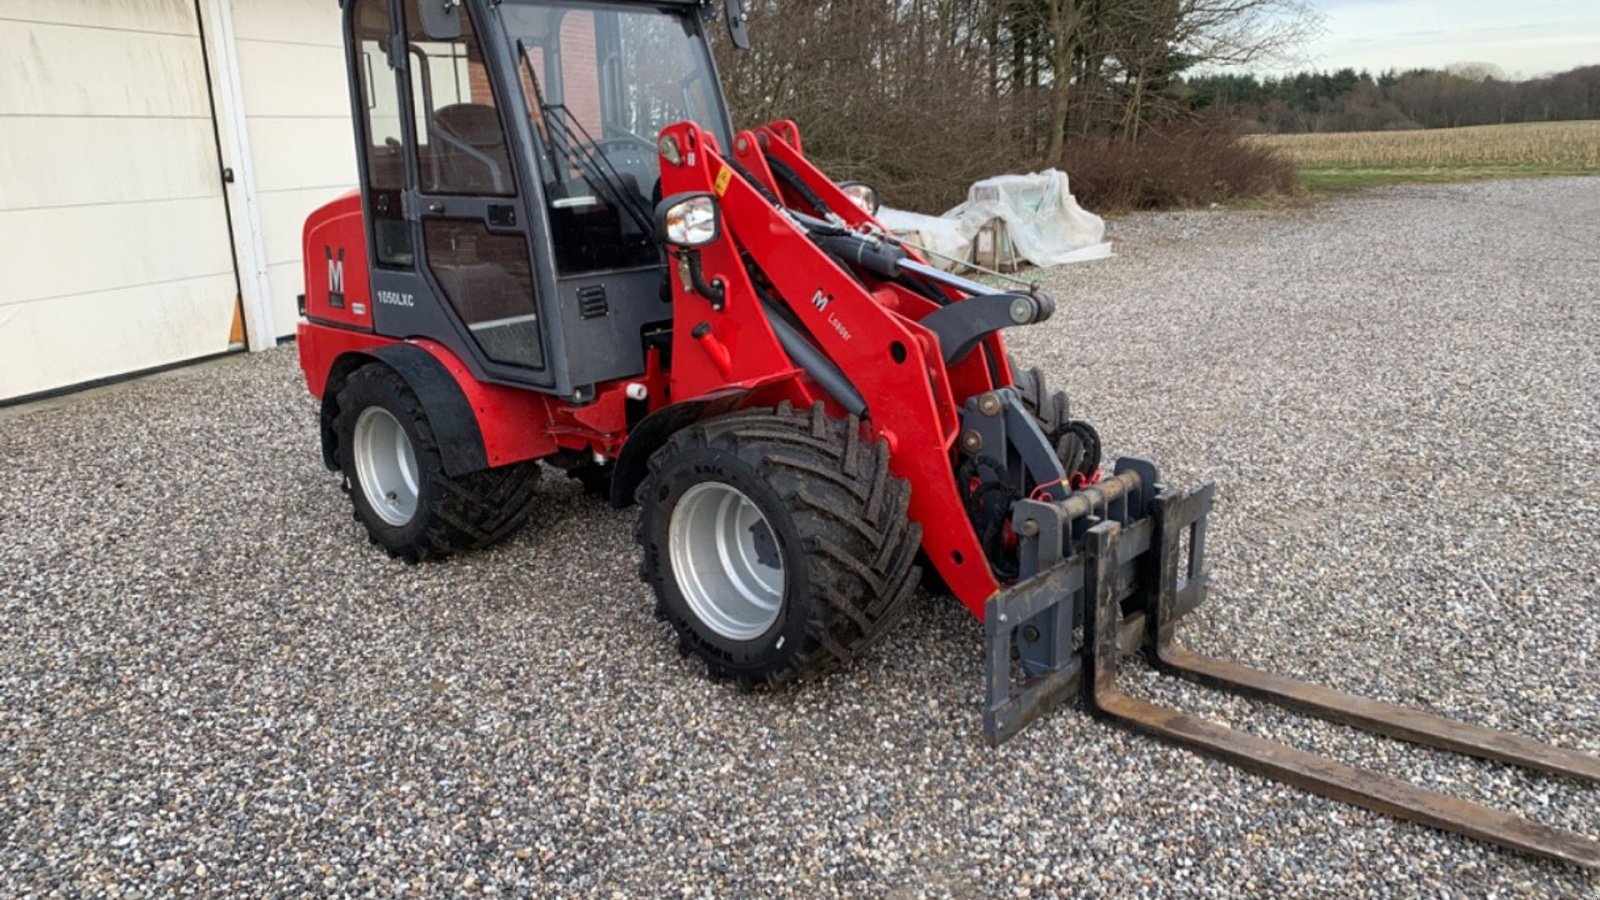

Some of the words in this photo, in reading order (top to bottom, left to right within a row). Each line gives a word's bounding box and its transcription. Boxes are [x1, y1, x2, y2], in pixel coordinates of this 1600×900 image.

[328, 259, 344, 293] M
[377, 290, 415, 307] 1050LXC
[811, 289, 829, 312] M
[827, 312, 851, 341] Loader
